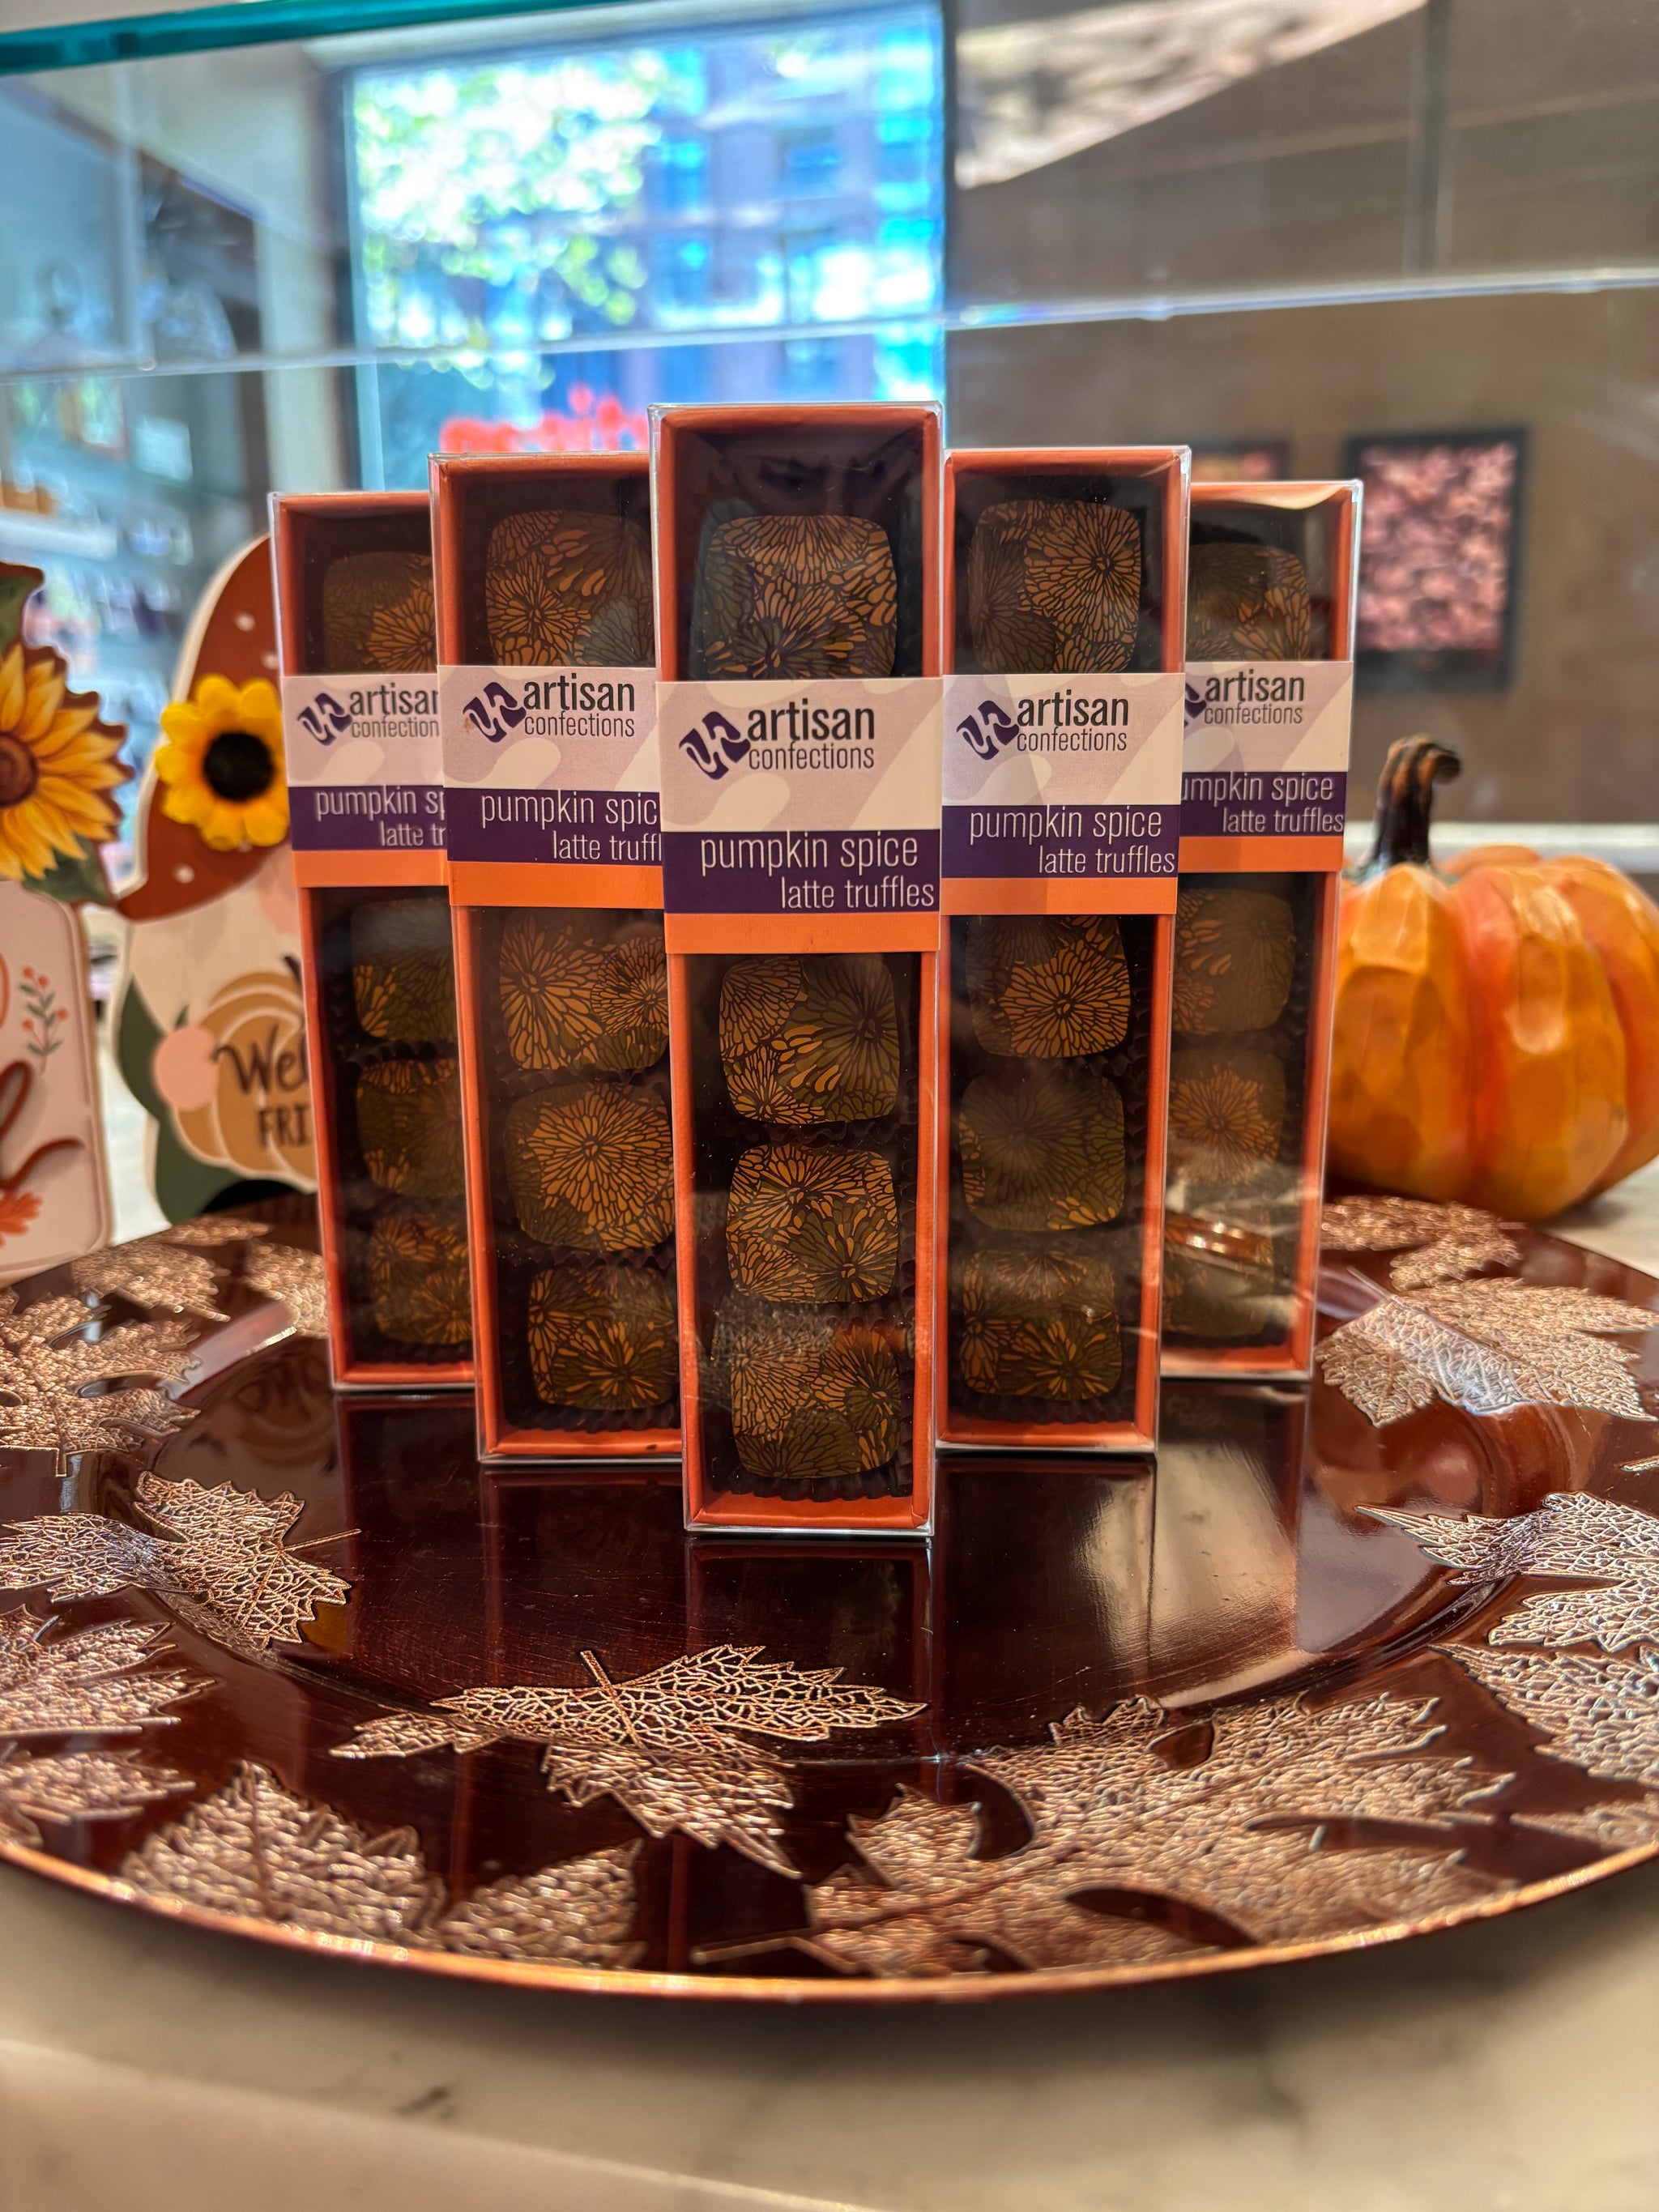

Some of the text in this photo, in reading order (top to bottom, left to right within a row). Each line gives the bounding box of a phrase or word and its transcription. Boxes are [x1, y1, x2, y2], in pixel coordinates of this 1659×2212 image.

[523, 673, 635, 712] artisan
[1204, 671, 1304, 703] artisan
[524, 710, 635, 738] confections
[748, 698, 874, 741] artisan
[1017, 689, 1129, 727] artisan
[1204, 701, 1303, 725] confections
[748, 740, 874, 769] confections
[1017, 727, 1127, 752] confections
[316, 784, 417, 821] pumpkin
[1272, 772, 1333, 808] spice
[481, 789, 595, 829] pumpkin
[970, 806, 1162, 845] pumpkin spice
[1222, 807, 1344, 833] latte truffles
[380, 820, 424, 846] latte
[552, 830, 601, 859] latte
[701, 829, 918, 876] pumpkin spice
[1038, 845, 1175, 874] latte truffles
[781, 875, 934, 909] latte truffles
